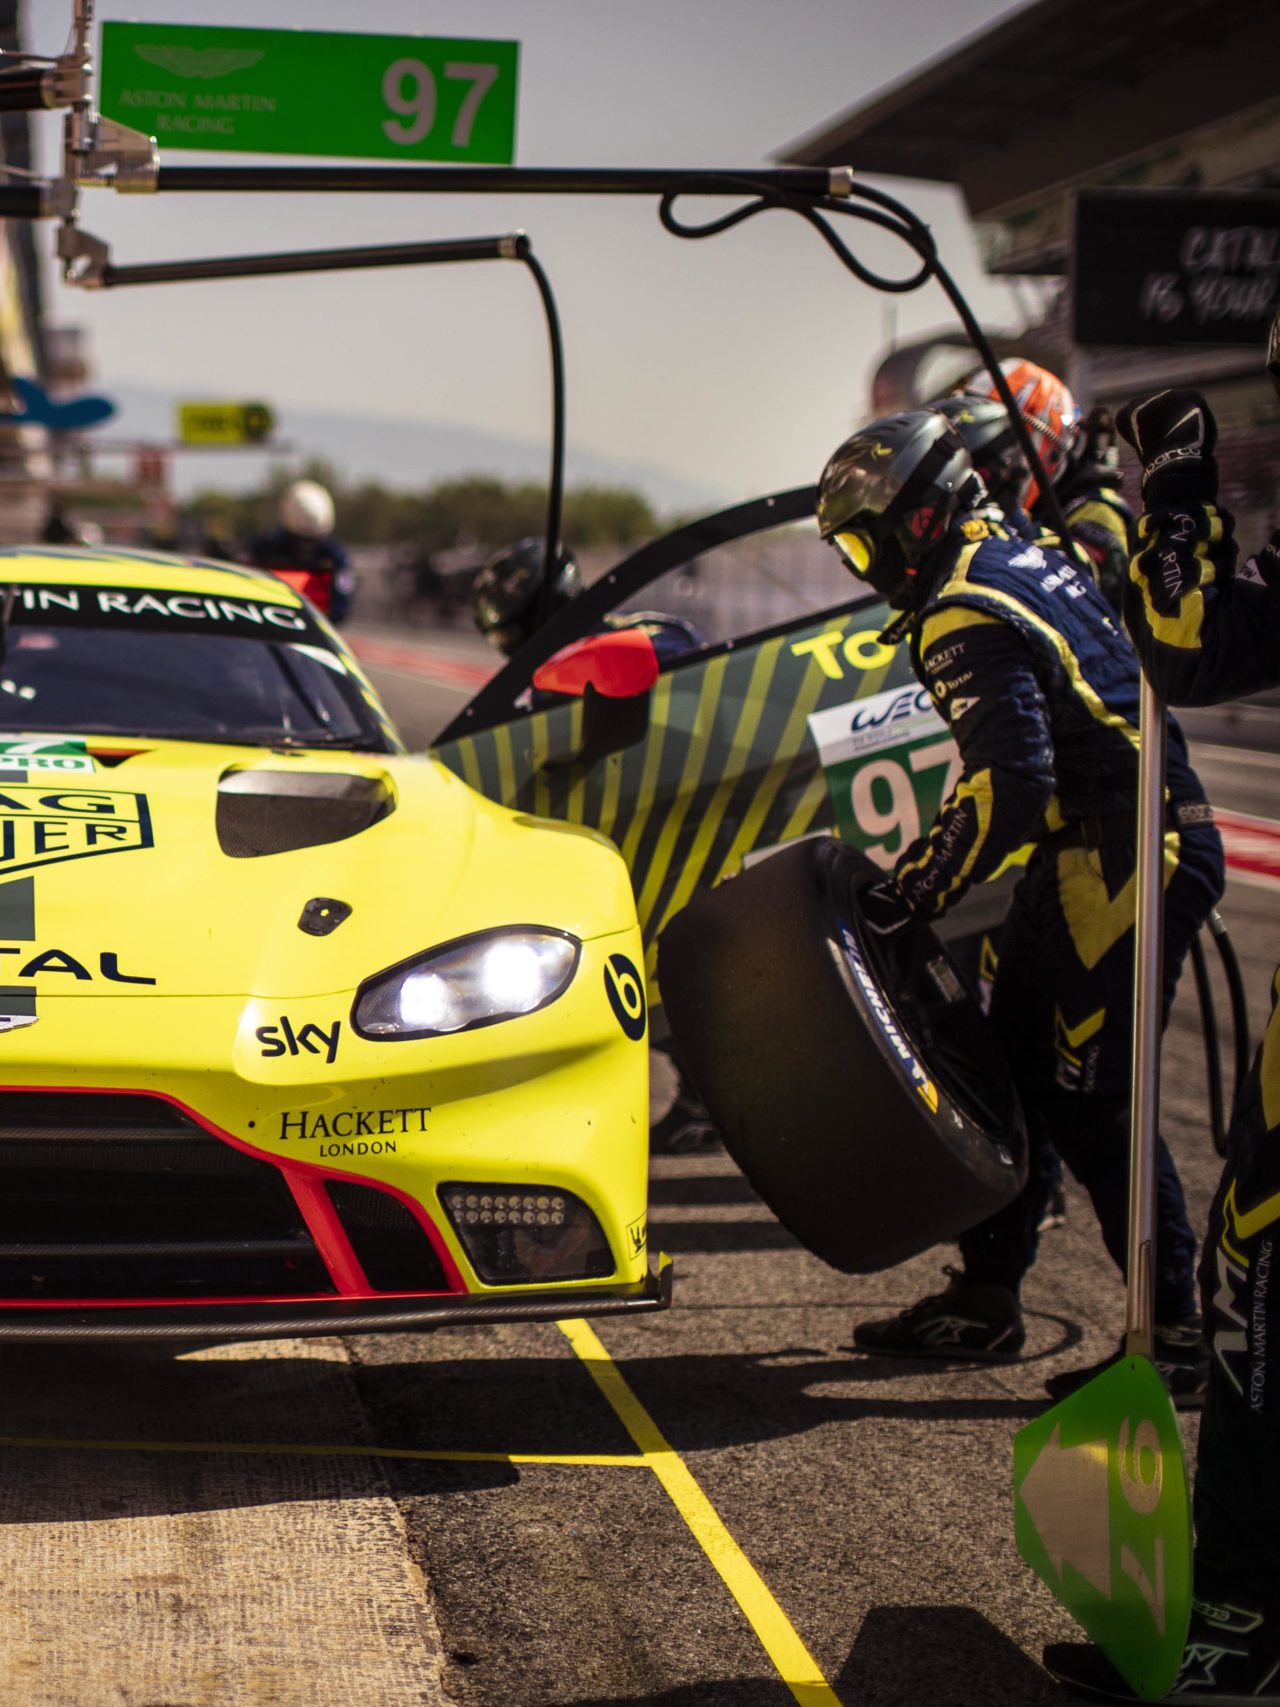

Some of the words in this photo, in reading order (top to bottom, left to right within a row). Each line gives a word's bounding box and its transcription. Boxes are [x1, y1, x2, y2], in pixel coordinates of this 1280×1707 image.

[119, 89, 187, 110] ASTON
[193, 92, 277, 113] MARTIN
[156, 115, 235, 134] RACING
[381, 58, 499, 147] 97
[1154, 550, 1184, 599] RTIN
[97, 591, 307, 630] RACING
[841, 926, 912, 1061] MICHELIN
[255, 1015, 342, 1064] sky
[278, 1107, 432, 1140] HACKETT
[319, 1140, 398, 1158] LONDON
[1253, 1239, 1274, 1299] RACING
[1251, 1300, 1269, 1362] MARTIN
[1249, 1361, 1267, 1416] ASTON
